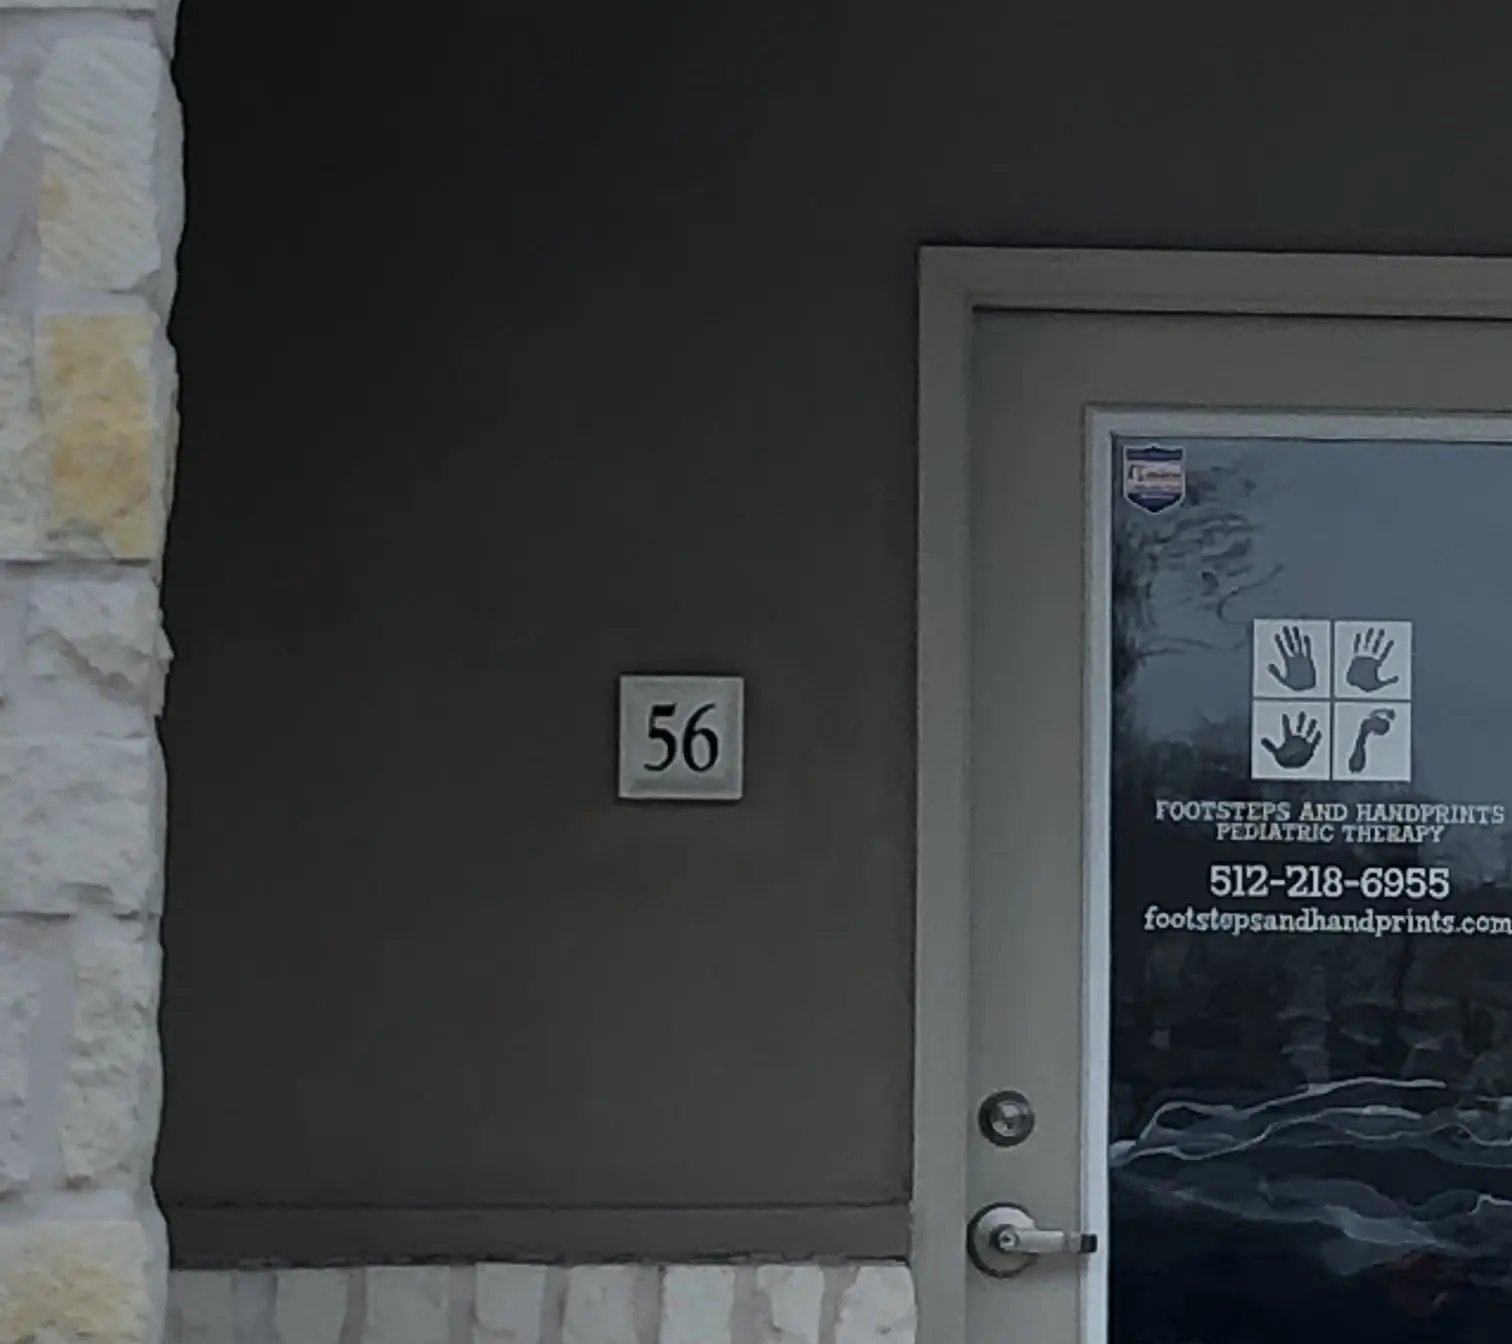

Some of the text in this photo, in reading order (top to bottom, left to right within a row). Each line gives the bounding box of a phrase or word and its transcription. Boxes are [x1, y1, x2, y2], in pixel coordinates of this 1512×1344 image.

[643, 702, 719, 773] 56
[1155, 800, 1505, 825] FOOTSTEPS AND HANDPRINTS
[1215, 822, 1445, 844] PEDIATRIC THERAPY
[1209, 864, 1451, 900] 512-218-6955
